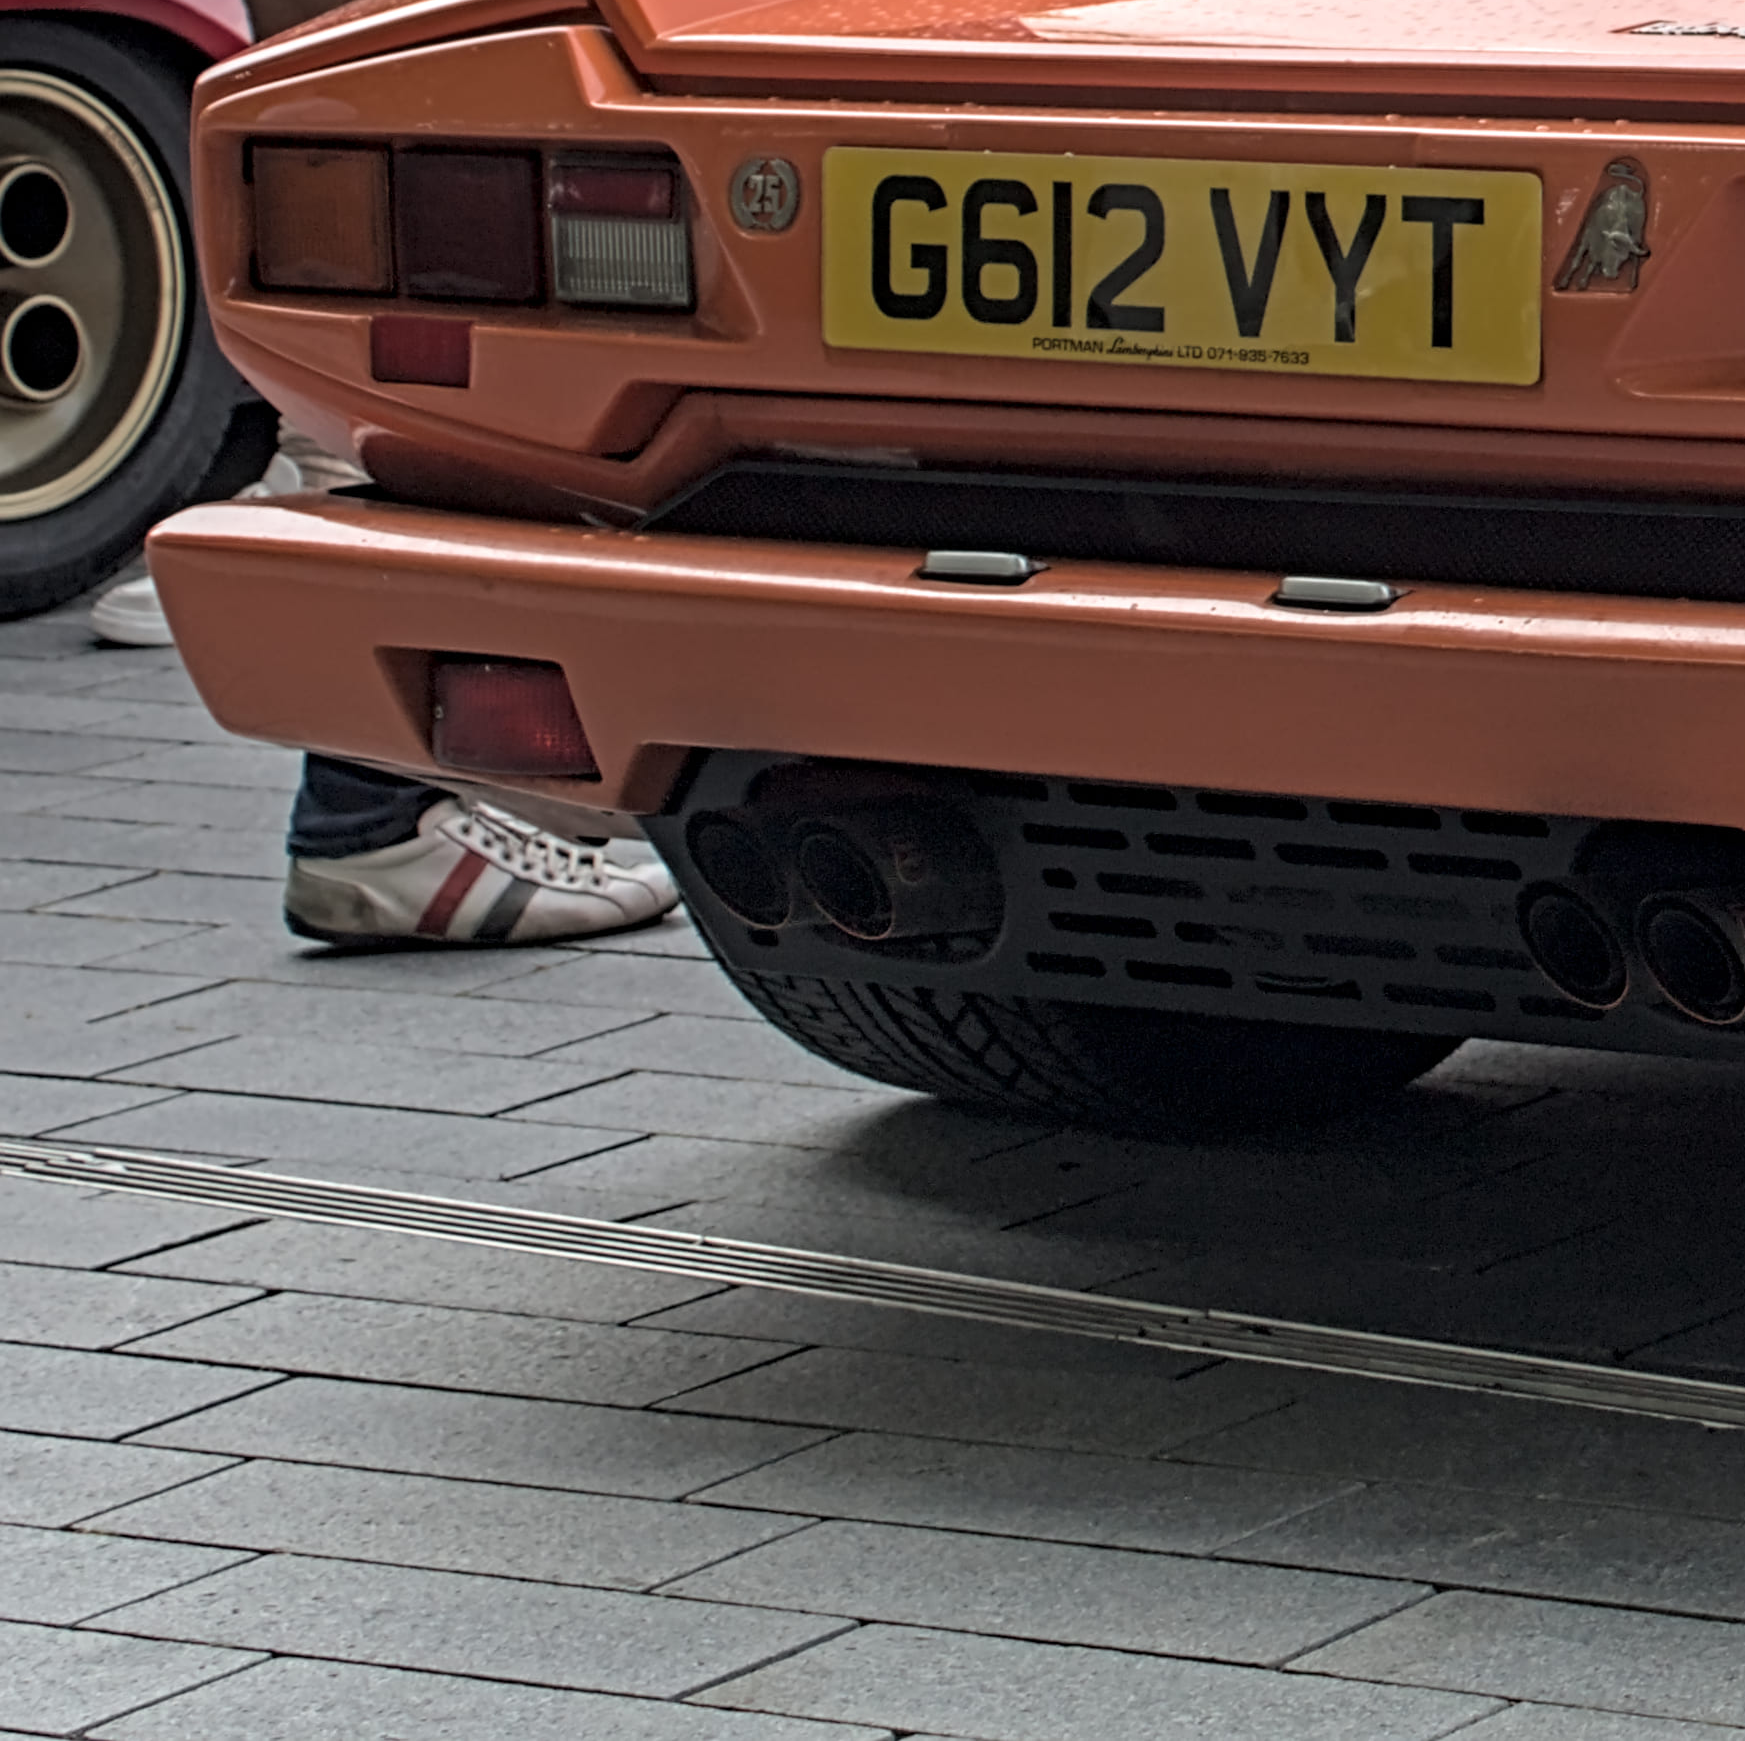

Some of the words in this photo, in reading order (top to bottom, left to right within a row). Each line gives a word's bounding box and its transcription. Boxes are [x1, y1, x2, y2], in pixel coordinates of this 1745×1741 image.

[871, 173, 1166, 333] G612
[1209, 186, 1485, 349] VYT
[1032, 336, 1104, 354] PORTMAN
[1177, 344, 1203, 360] LTD
